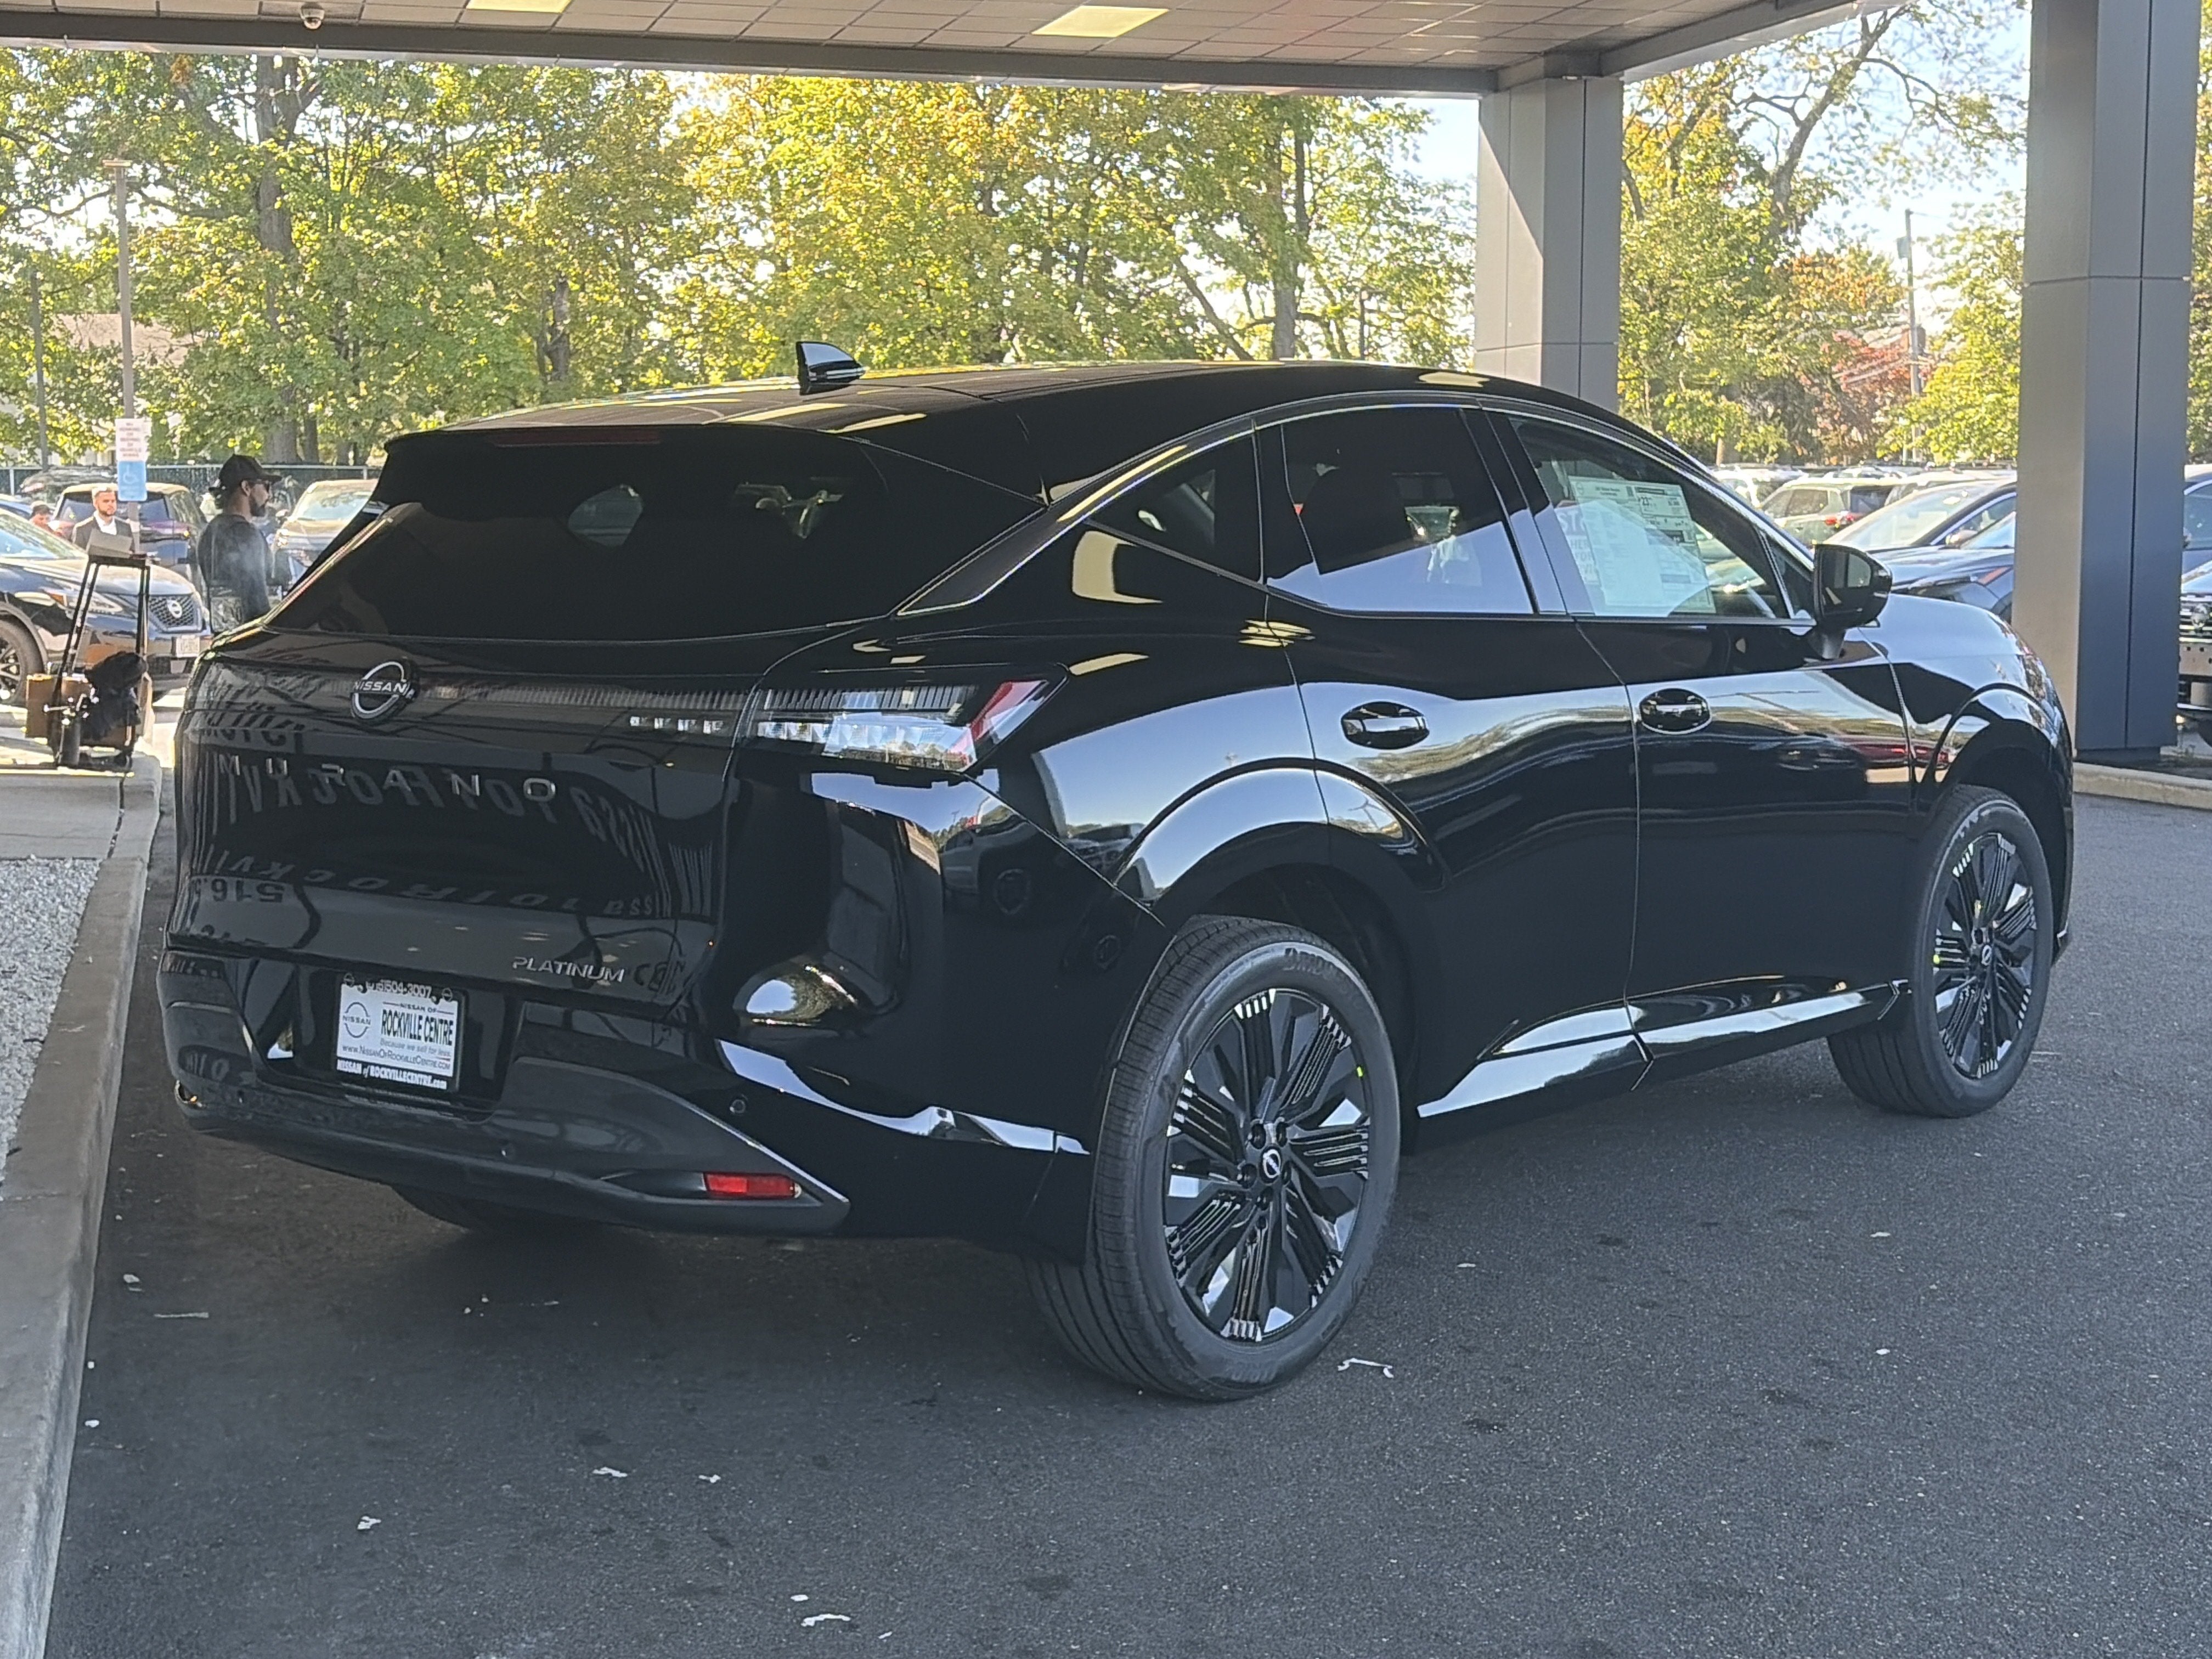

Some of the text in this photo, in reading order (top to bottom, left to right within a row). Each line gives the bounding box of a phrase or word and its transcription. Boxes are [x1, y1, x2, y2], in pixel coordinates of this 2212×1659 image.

[353, 680, 408, 694] NISSAN
[219, 754, 556, 803] MURANO
[512, 956, 625, 983] PLATINUM
[400, 1003, 425, 1012] NISSAN
[342, 1015, 371, 1025] NISSAN
[381, 1008, 454, 1046] ROCKVILLE CENTRE
[336, 1059, 362, 1075] NISSAN
